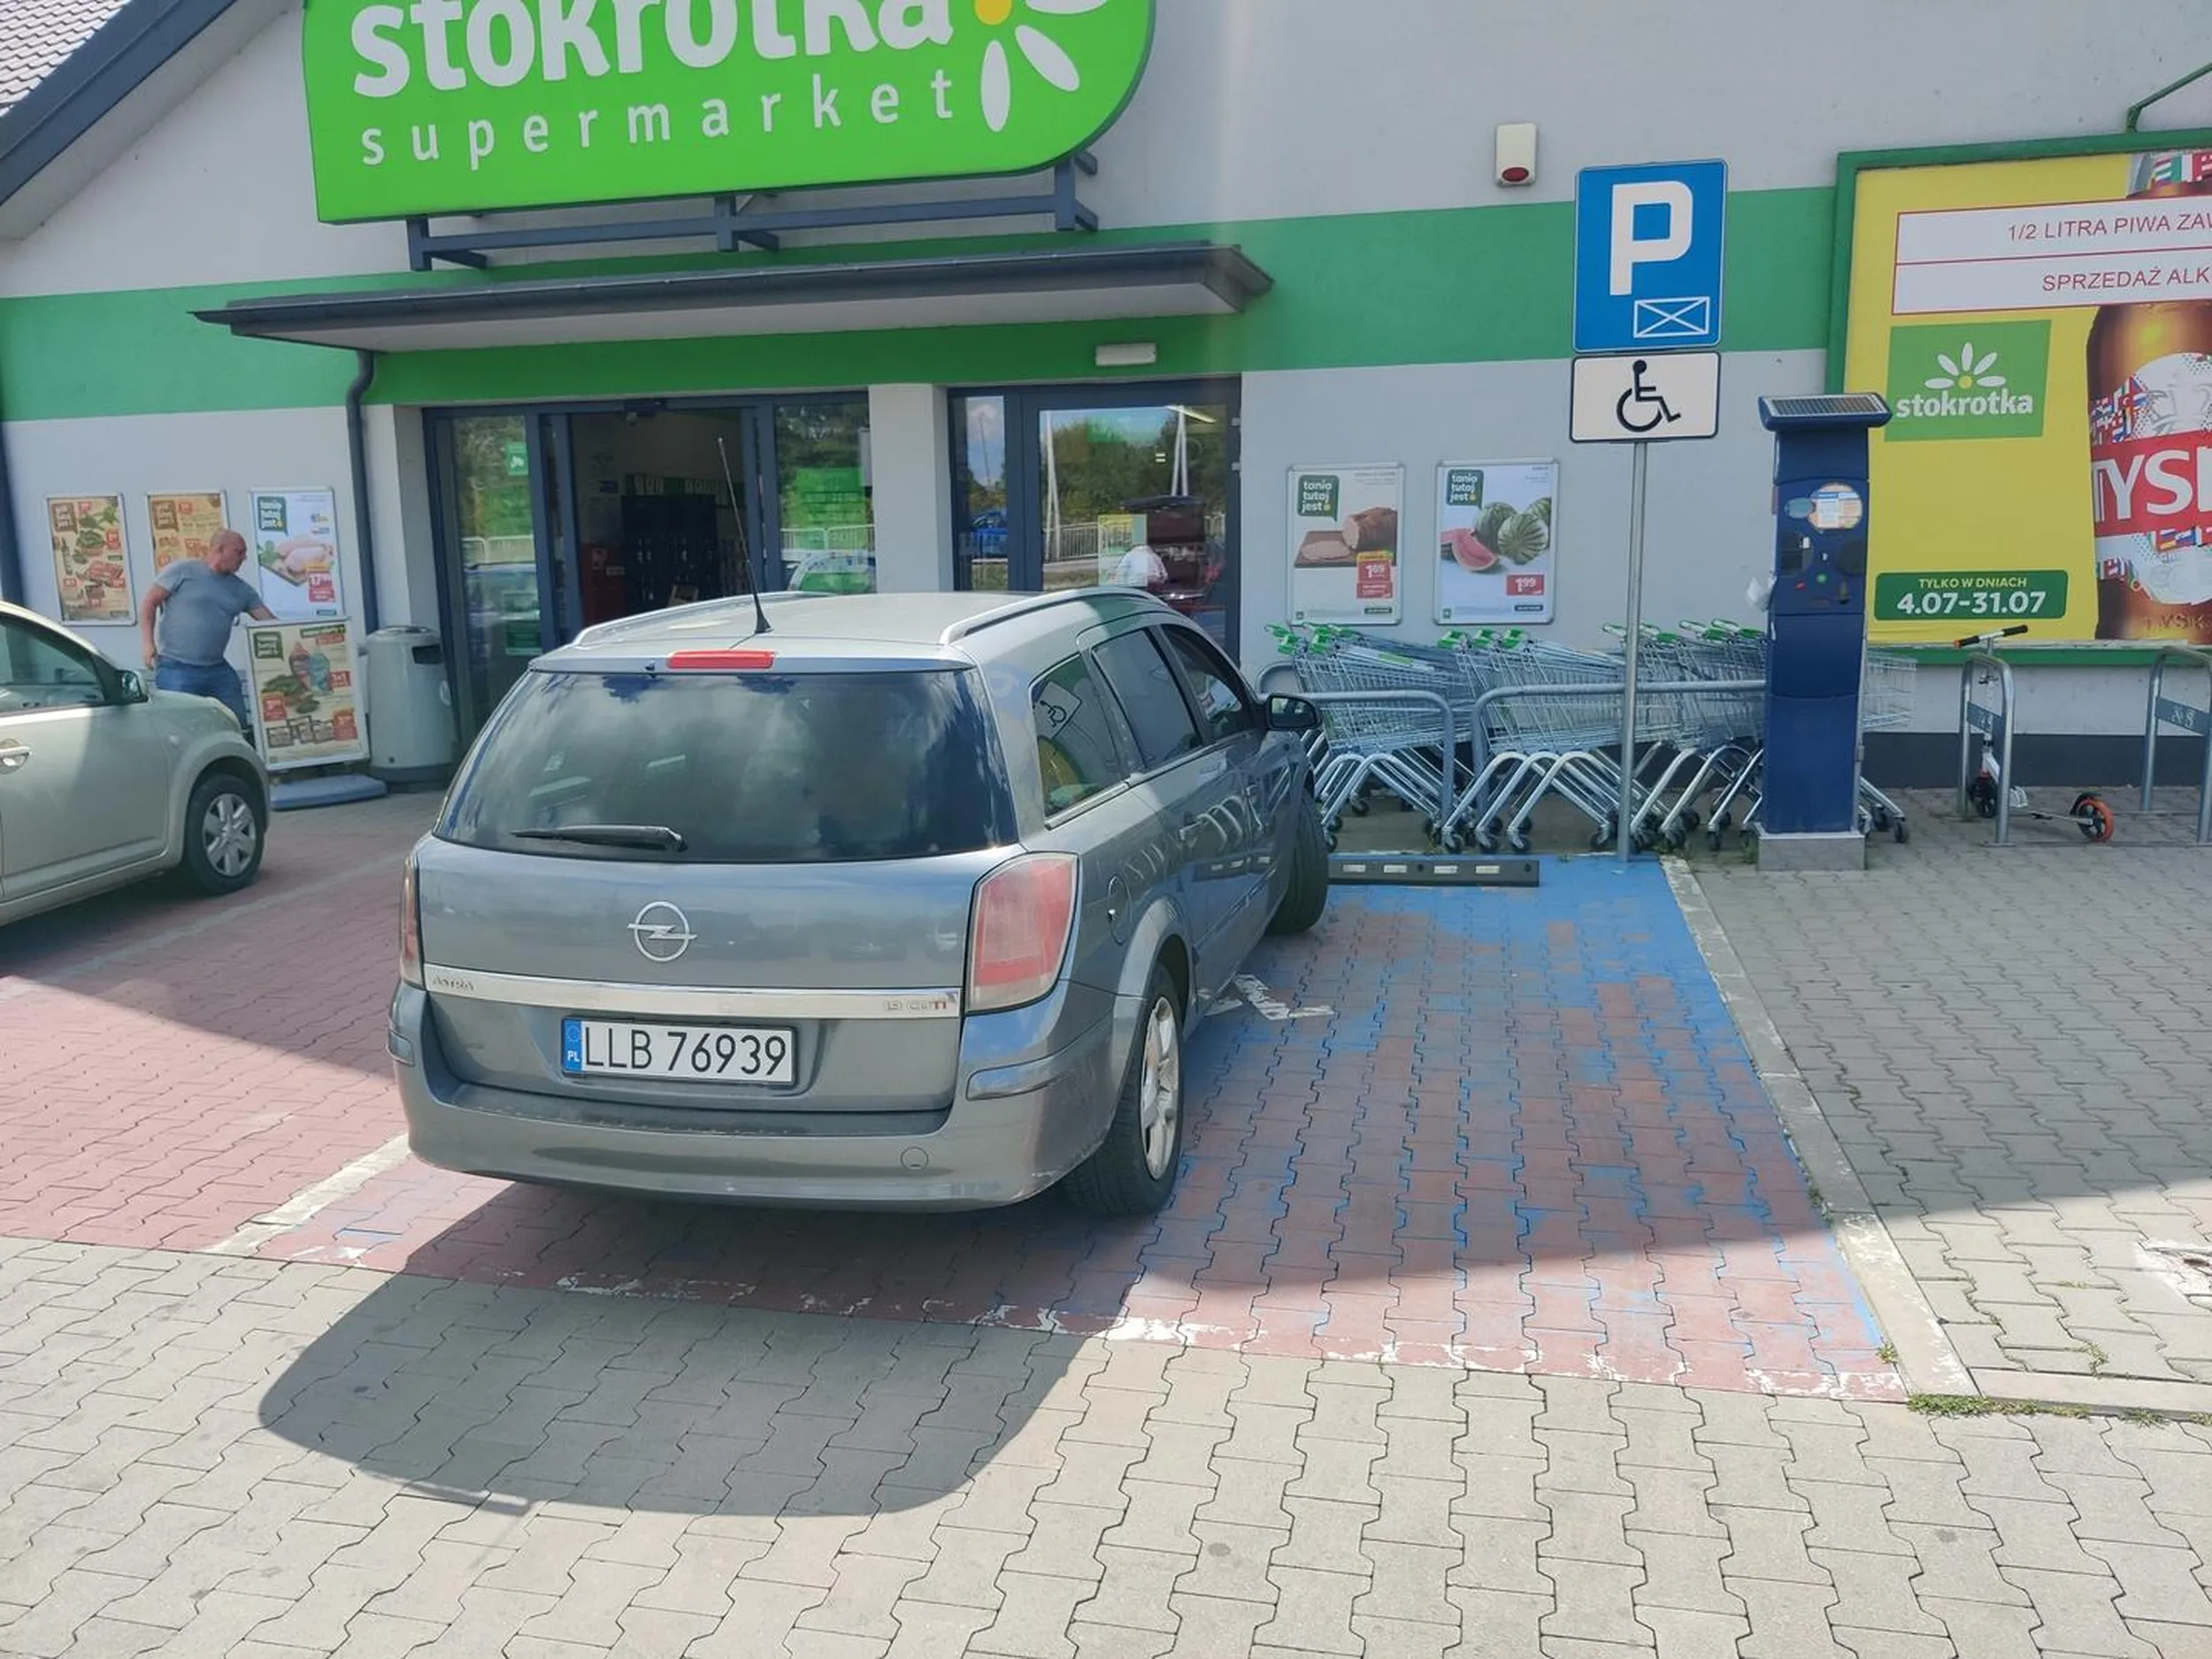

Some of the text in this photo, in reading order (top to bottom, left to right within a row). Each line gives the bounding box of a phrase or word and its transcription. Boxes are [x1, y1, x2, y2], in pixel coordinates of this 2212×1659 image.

[361, 68, 953, 172] supermarket
[1609, 180, 1694, 296] P
[2008, 223, 2037, 242] 1/2
[2045, 219, 2108, 239] LITRA
[2114, 214, 2170, 234] PIWA
[2042, 265, 2162, 292] SPRZEDAŻ
[1896, 388, 2034, 418] stokrotka
[1302, 491, 1330, 503] tutaj
[1303, 479, 1333, 490] tanio
[1918, 577, 2027, 588] TYLKO W DNIACH
[1897, 590, 2047, 615] 4.07-31.07
[567, 1049, 580, 1063] PL
[585, 1026, 787, 1076] LLB 76939
